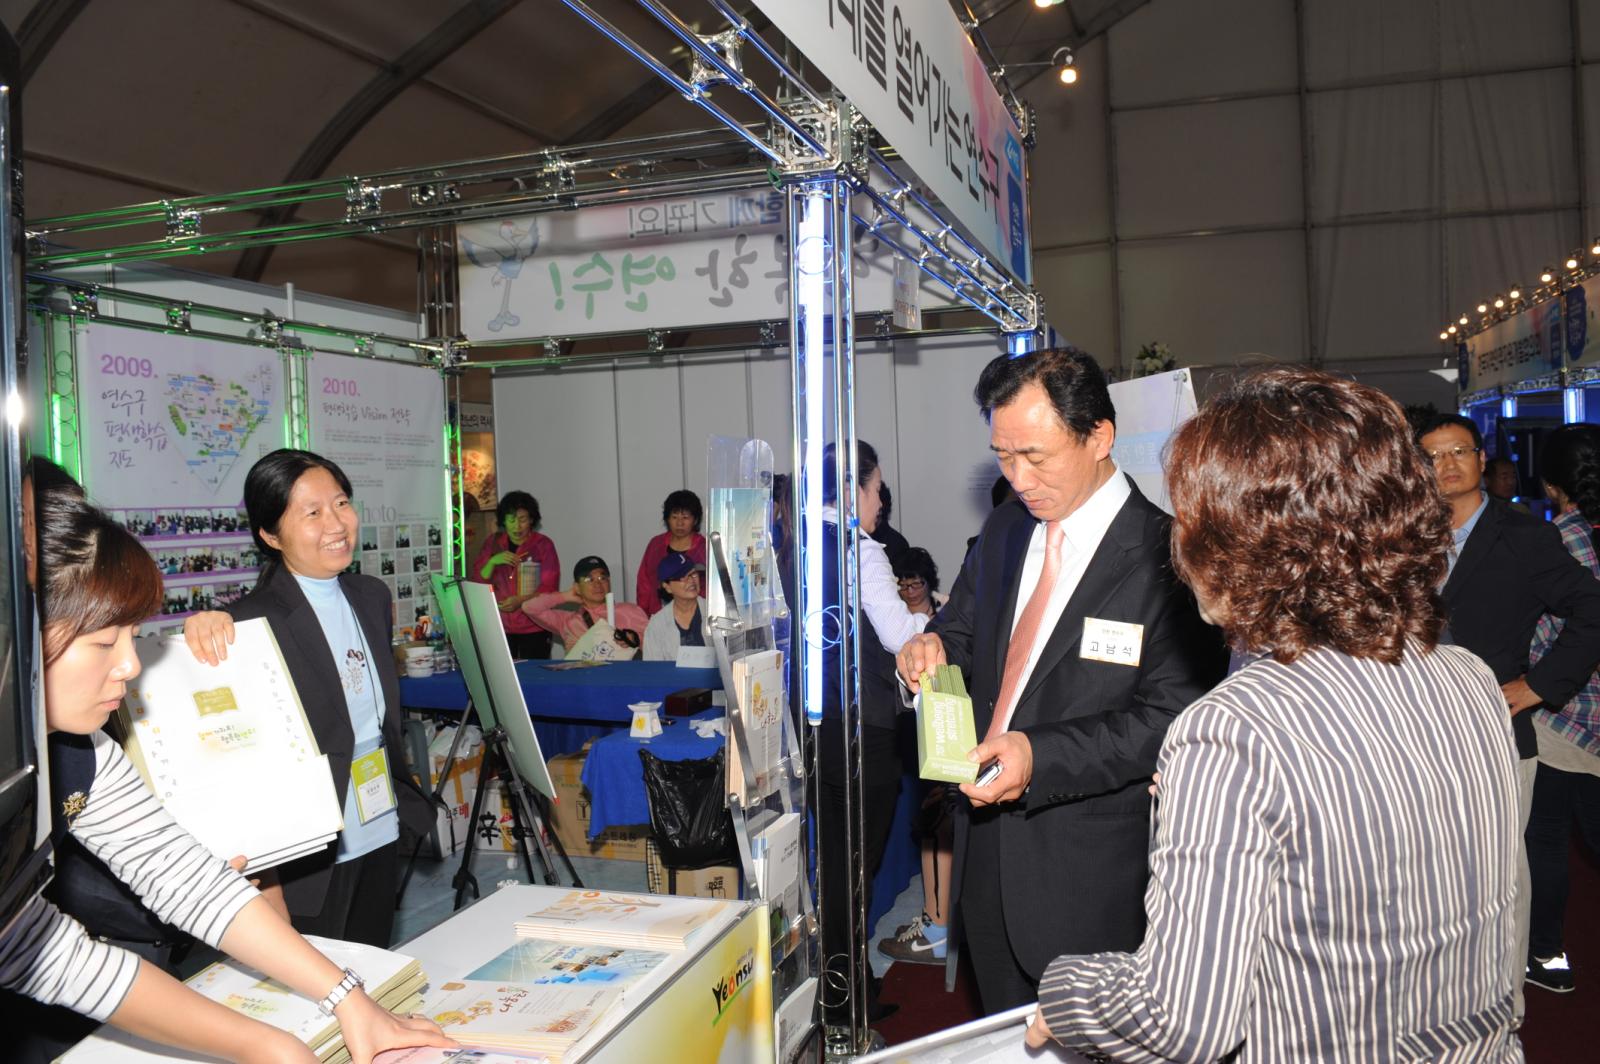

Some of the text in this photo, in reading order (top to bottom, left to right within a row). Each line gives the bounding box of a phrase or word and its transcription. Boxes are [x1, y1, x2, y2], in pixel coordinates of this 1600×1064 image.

[892, 4, 964, 183] 열어가는
[963, 112, 1001, 225] 연수구
[101, 354, 159, 379] 2009.
[322, 377, 361, 397] 2010.
[101, 389, 148, 417] 연수구
[104, 419, 168, 451] 평생학습
[108, 450, 136, 469] 지도
[359, 501, 397, 523] hoto
[711, 957, 754, 1015] Yeonsu
